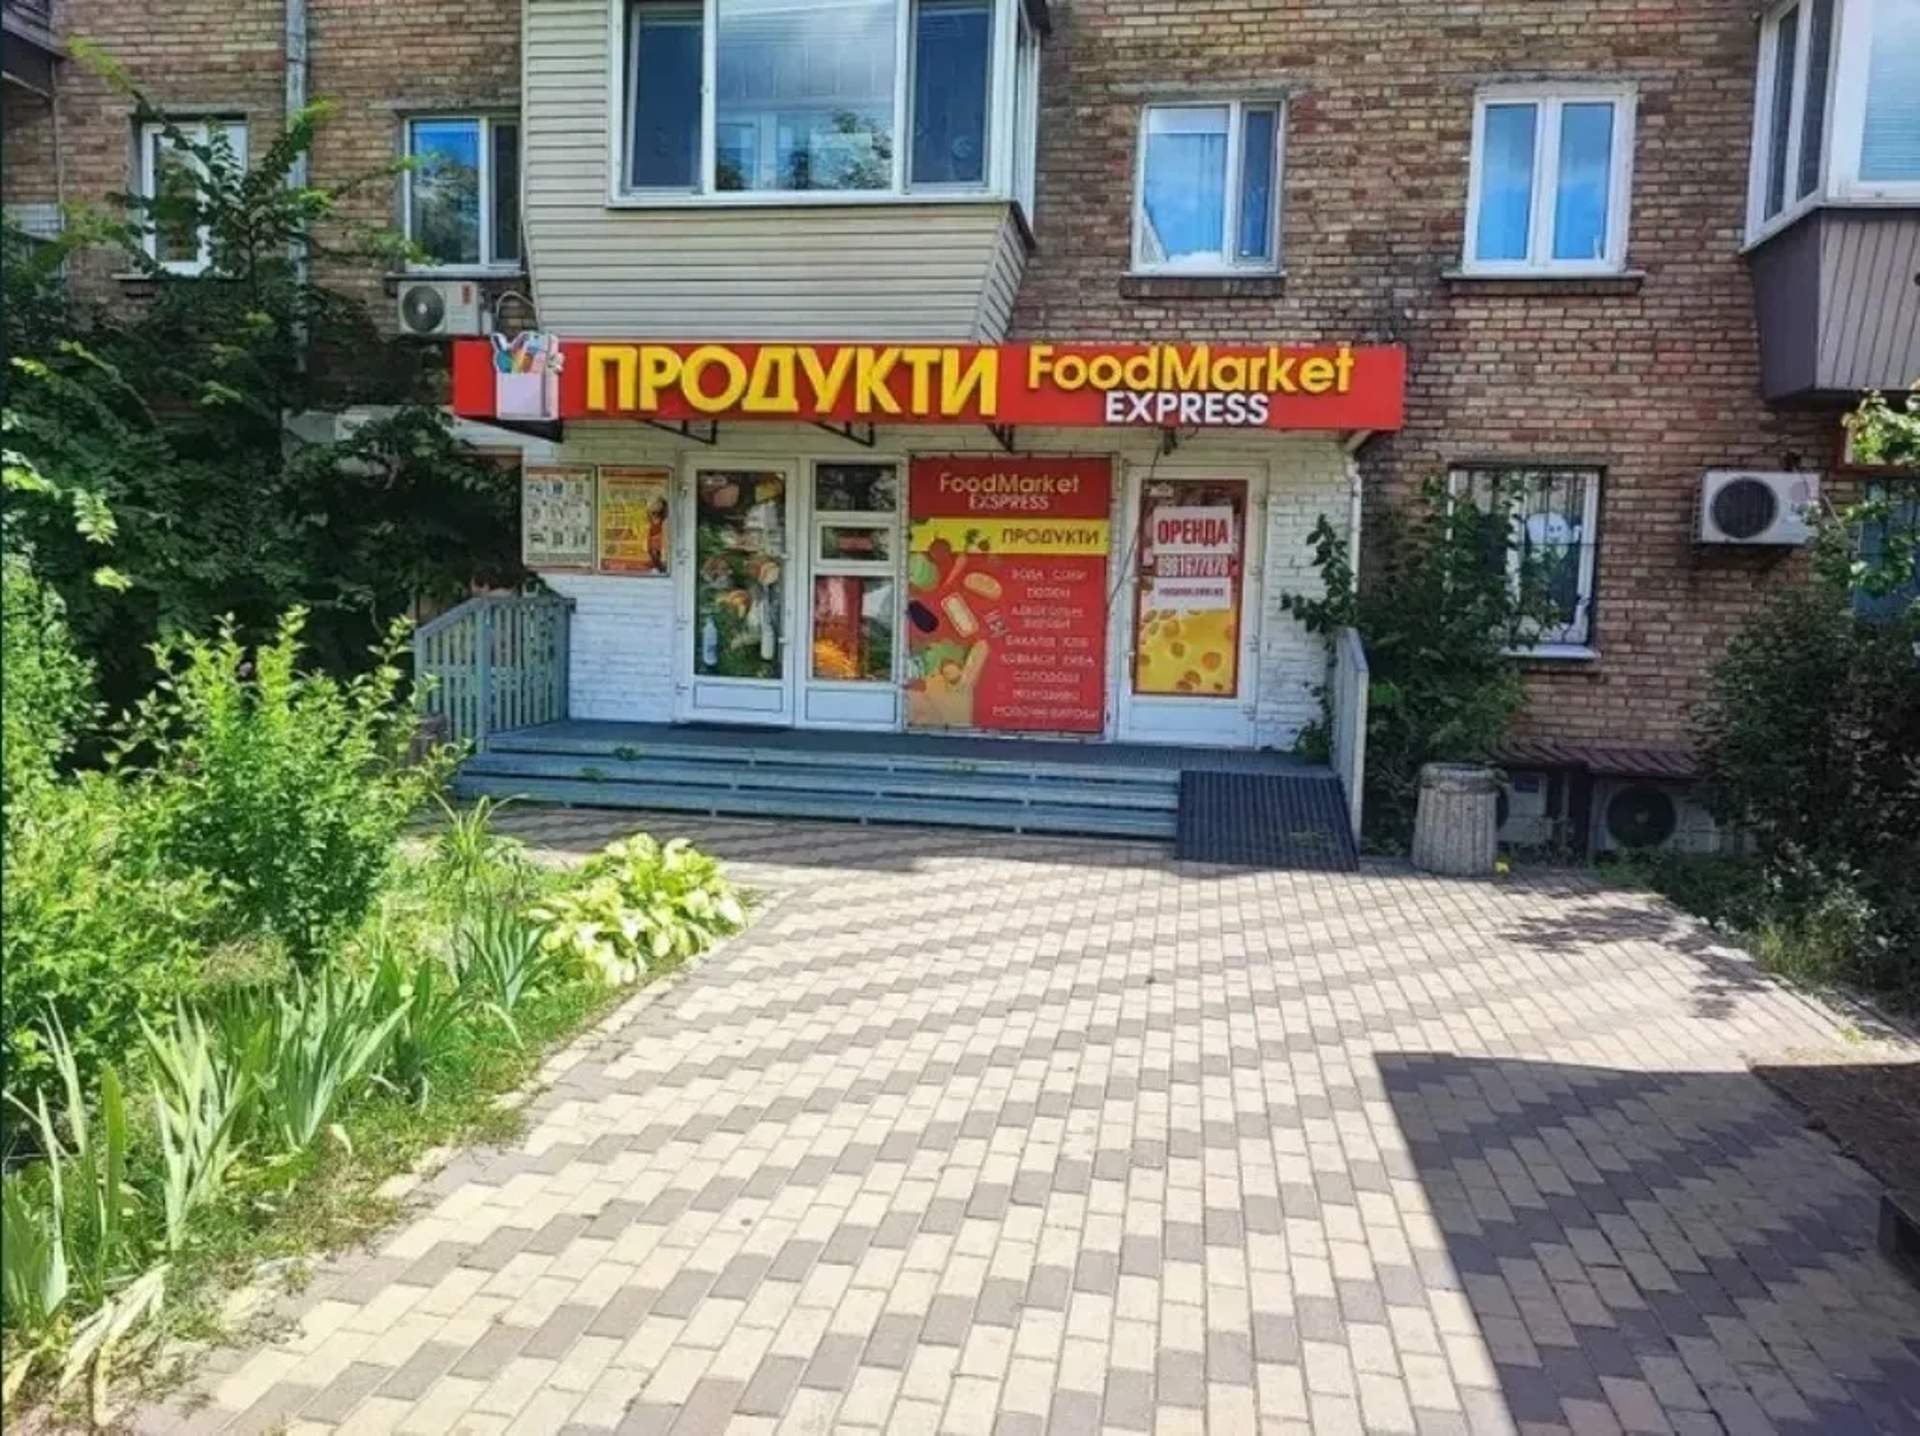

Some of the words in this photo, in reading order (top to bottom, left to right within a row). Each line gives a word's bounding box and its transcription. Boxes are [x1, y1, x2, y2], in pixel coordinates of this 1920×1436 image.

[586, 344, 998, 416] ПРОДУКТИ
[1027, 343, 1355, 393] FoodMarket
[1105, 391, 1269, 425] EXPRESS
[939, 472, 1081, 494] FoodMarket
[968, 494, 1050, 511] EXSPRESS
[1002, 527, 1100, 545] ПРОДУКТИ
[1158, 519, 1229, 547] ОРЕНДА
